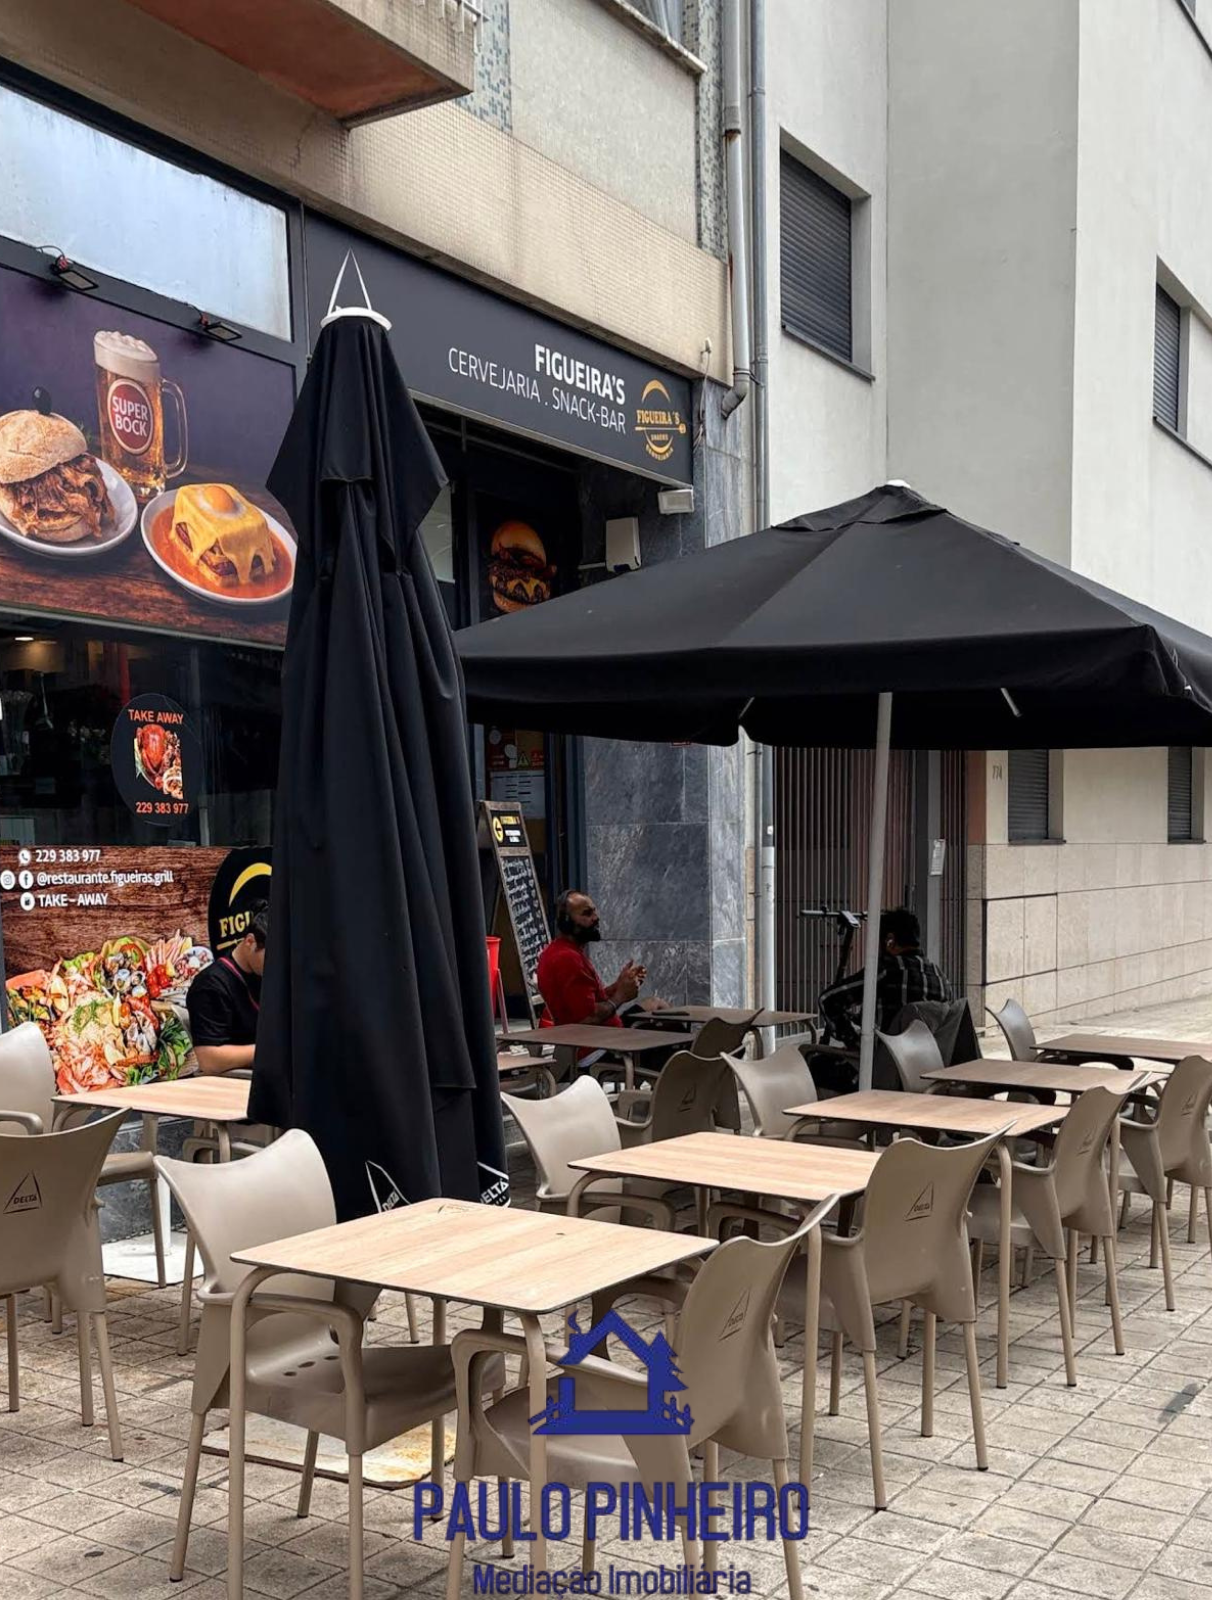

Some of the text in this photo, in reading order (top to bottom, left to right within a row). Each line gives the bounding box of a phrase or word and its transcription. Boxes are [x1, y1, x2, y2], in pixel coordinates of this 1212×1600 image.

[535, 343, 626, 405] FIGUEIRA'S
[448, 347, 541, 403] CERVEJARIA
[551, 386, 626, 435] SNACK-BAR
[112, 396, 149, 421] SUPER
[115, 415, 148, 437] BOCK
[128, 709, 184, 725] TAKE AWAY
[135, 802, 189, 815] 229 383 977
[35, 849, 101, 863] 229 383 977
[37, 869, 174, 887] @restaurante.figueiras.grill
[13, 1194, 37, 1204] DELTA
[480, 1179, 510, 1204] ELTA
